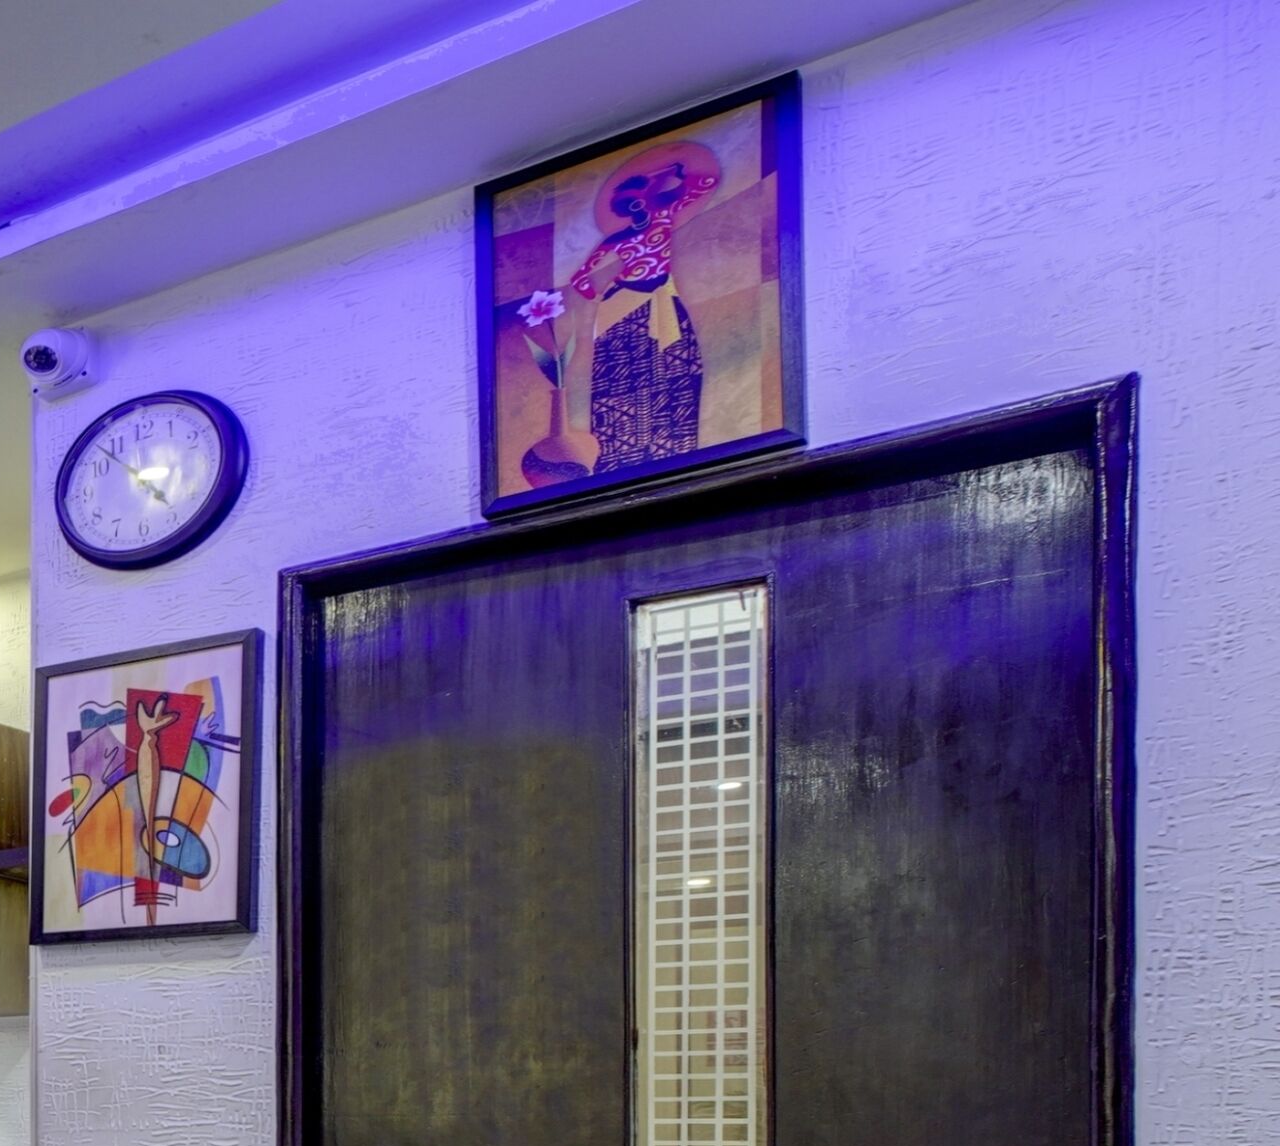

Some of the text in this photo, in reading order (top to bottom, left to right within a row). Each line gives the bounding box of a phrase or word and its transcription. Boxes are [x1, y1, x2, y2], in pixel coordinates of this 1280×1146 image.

[134, 420, 154, 442] 12
[167, 420, 174, 438] 1
[109, 436, 124, 456] 11
[187, 430, 199, 449] 2
[92, 457, 110, 478] 10
[91, 507, 103, 526] 8
[111, 518, 122, 538] 7
[138, 519, 150, 537] 6
